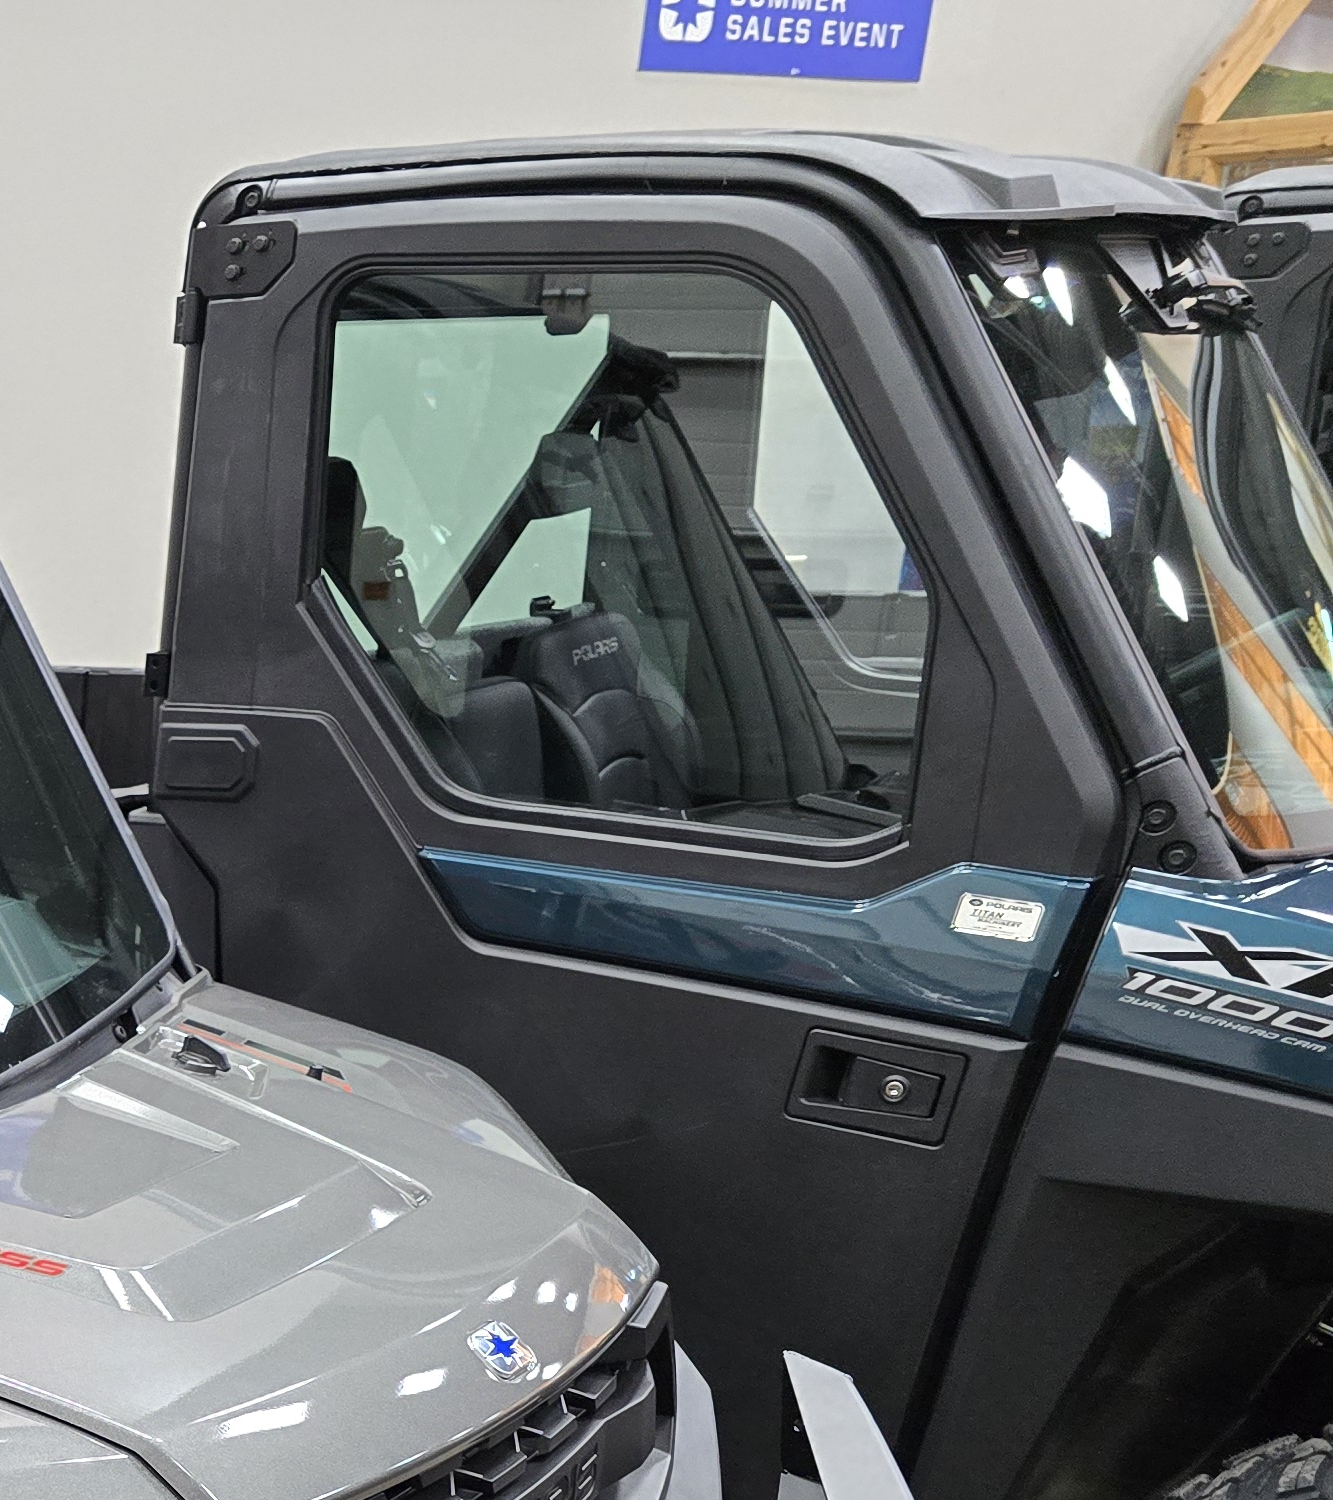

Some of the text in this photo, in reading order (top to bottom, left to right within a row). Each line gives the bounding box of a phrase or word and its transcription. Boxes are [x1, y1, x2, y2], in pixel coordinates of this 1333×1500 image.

[725, 14, 905, 48] SALES EVENT
[970, 908, 1005, 919] TITAN
[985, 901, 1033, 914] POLARIS
[1123, 972, 1333, 1039] 1000
[1118, 994, 1327, 1053] DUAL OVERHEAD CAM
